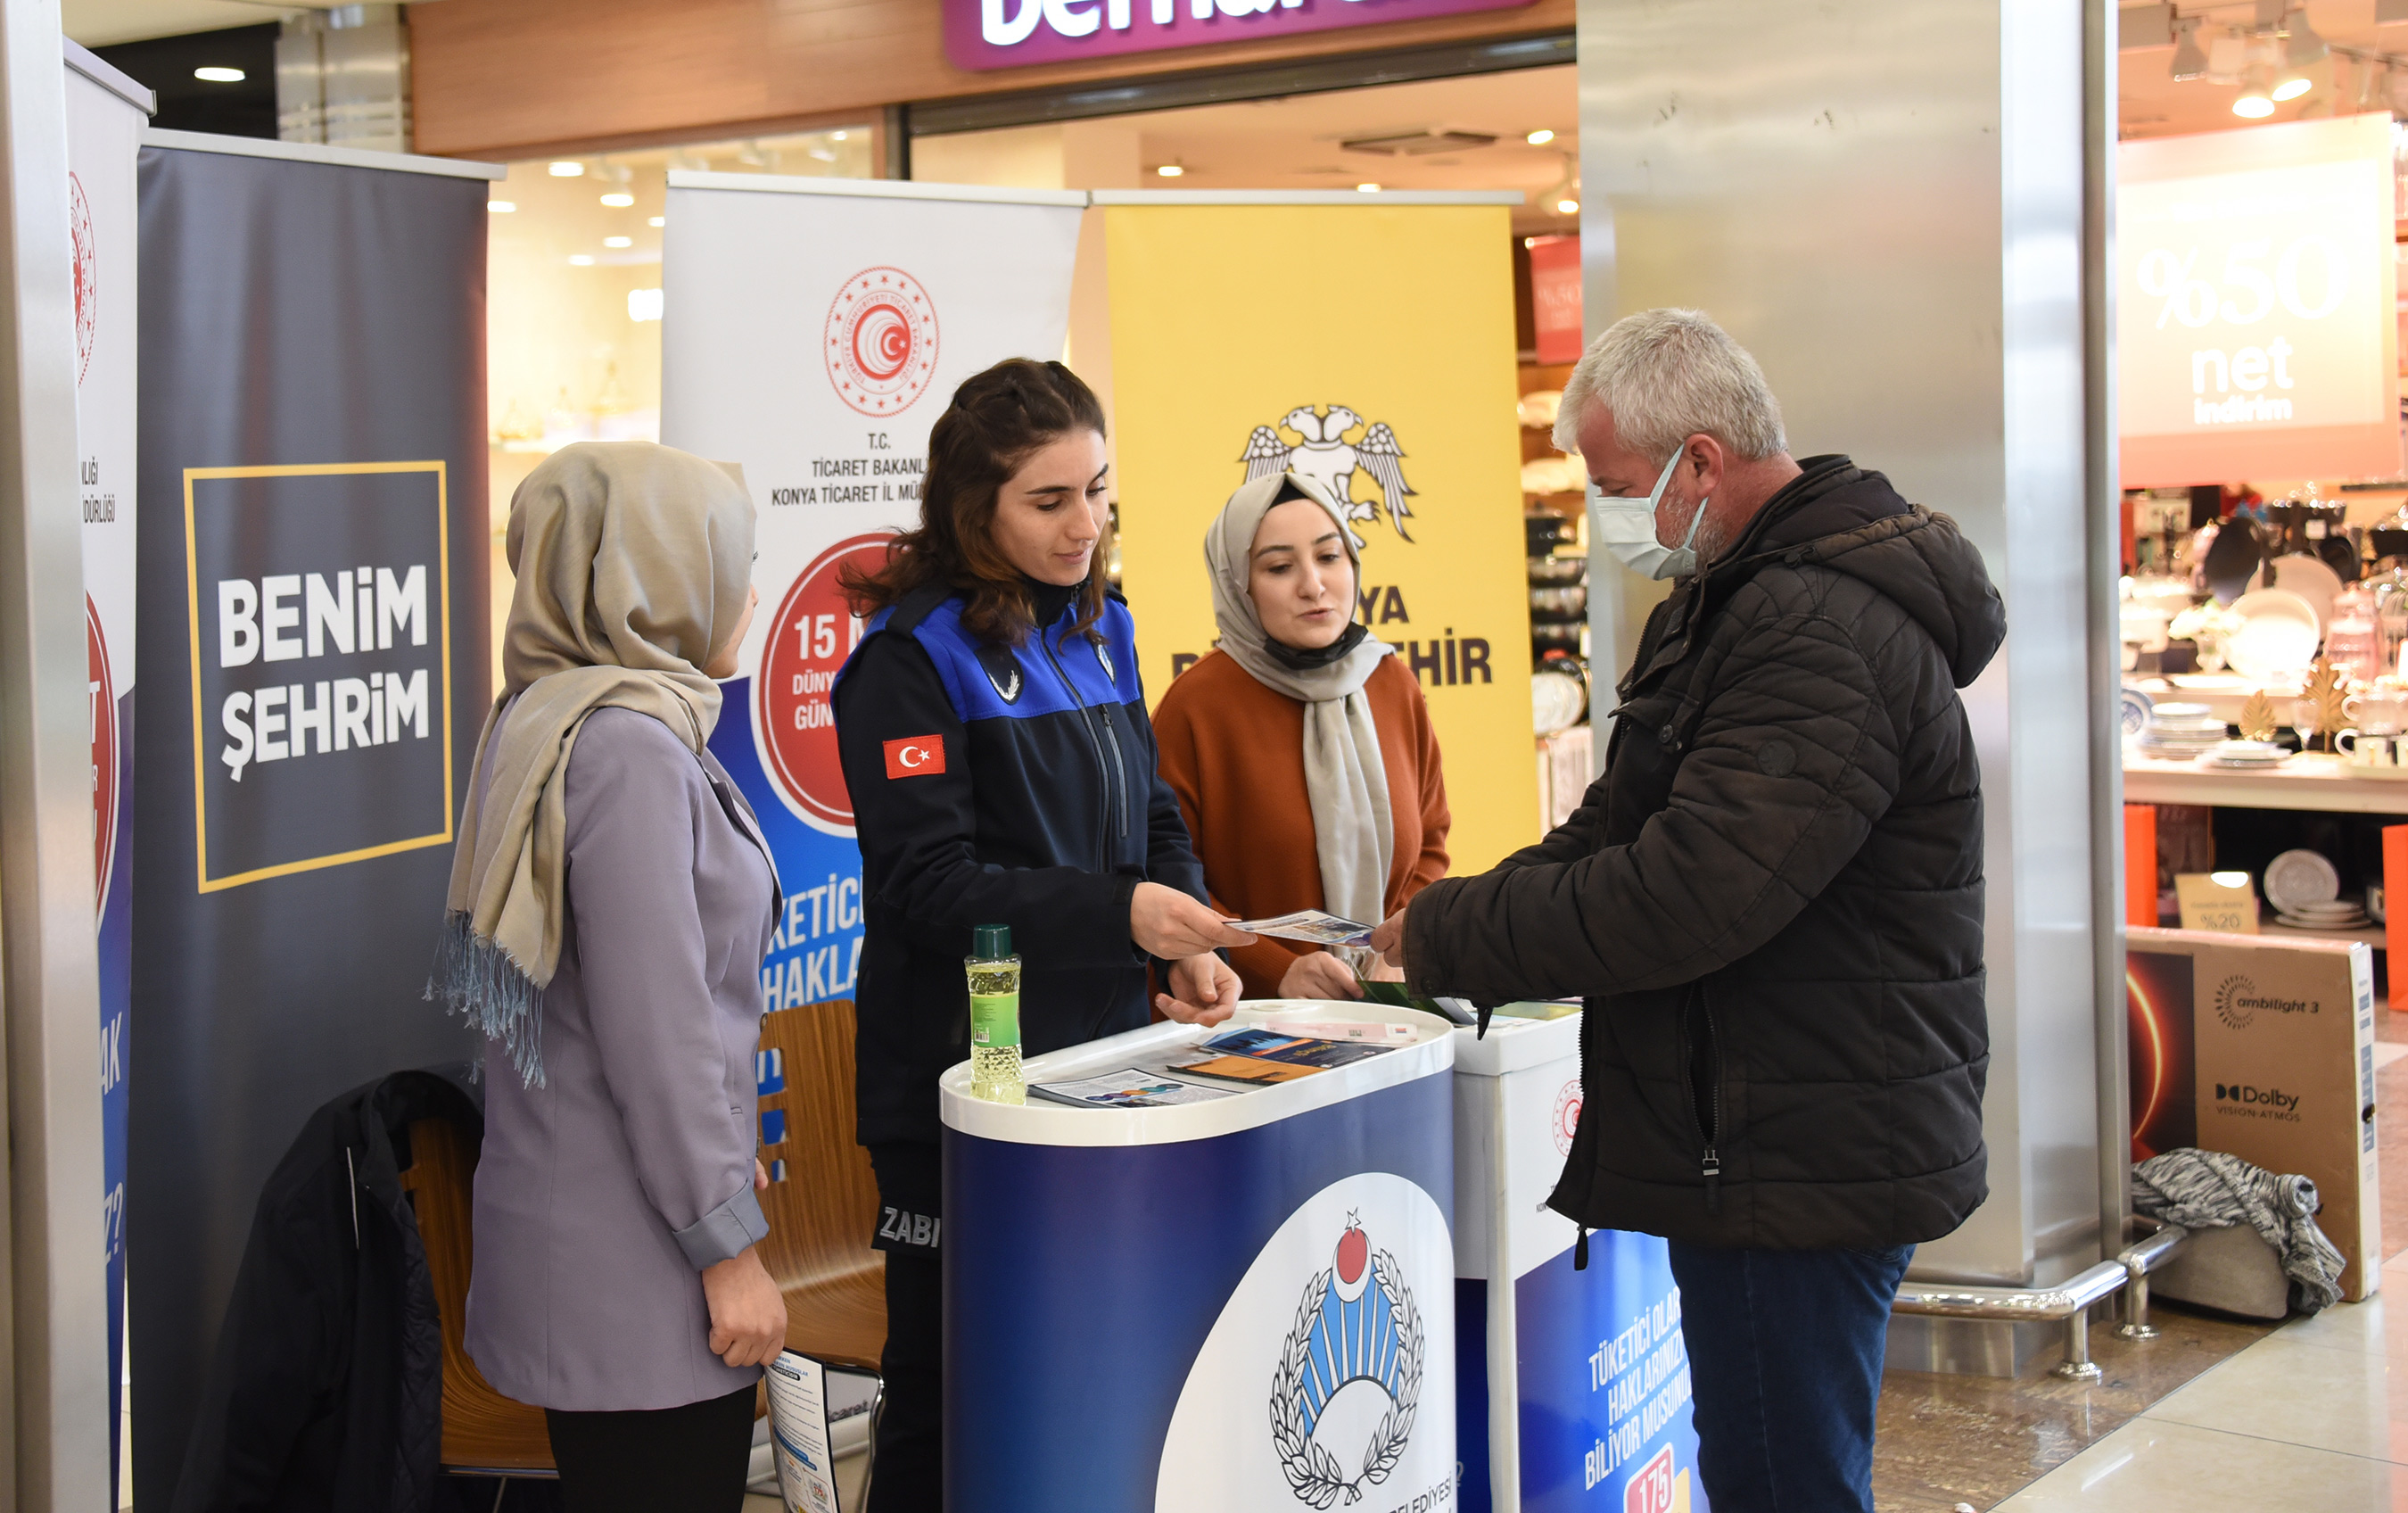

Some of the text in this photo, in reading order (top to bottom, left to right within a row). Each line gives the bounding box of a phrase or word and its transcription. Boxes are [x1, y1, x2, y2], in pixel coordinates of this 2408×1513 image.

[2136, 233, 2350, 330] %50
[2191, 335, 2295, 395] net
[2193, 393, 2293, 425] indirim
[867, 432, 891, 451] T.C.
[812, 456, 928, 477] TİCARET BAKANL
[771, 487, 818, 506] KONYA
[821, 483, 878, 503] TİCARET
[882, 481, 895, 500] İL
[794, 613, 836, 660] 15
[2200, 912, 2240, 930] %20
[2237, 997, 2320, 1014] ambilight 3
[2242, 1086, 2300, 1112] Dolby
[879, 1206, 941, 1248] ZABI
[1588, 1306, 1651, 1393] TÜKETİCİ
[1584, 1414, 1642, 1492] BİLİYOR
[1639, 1458, 1670, 1513] 175
